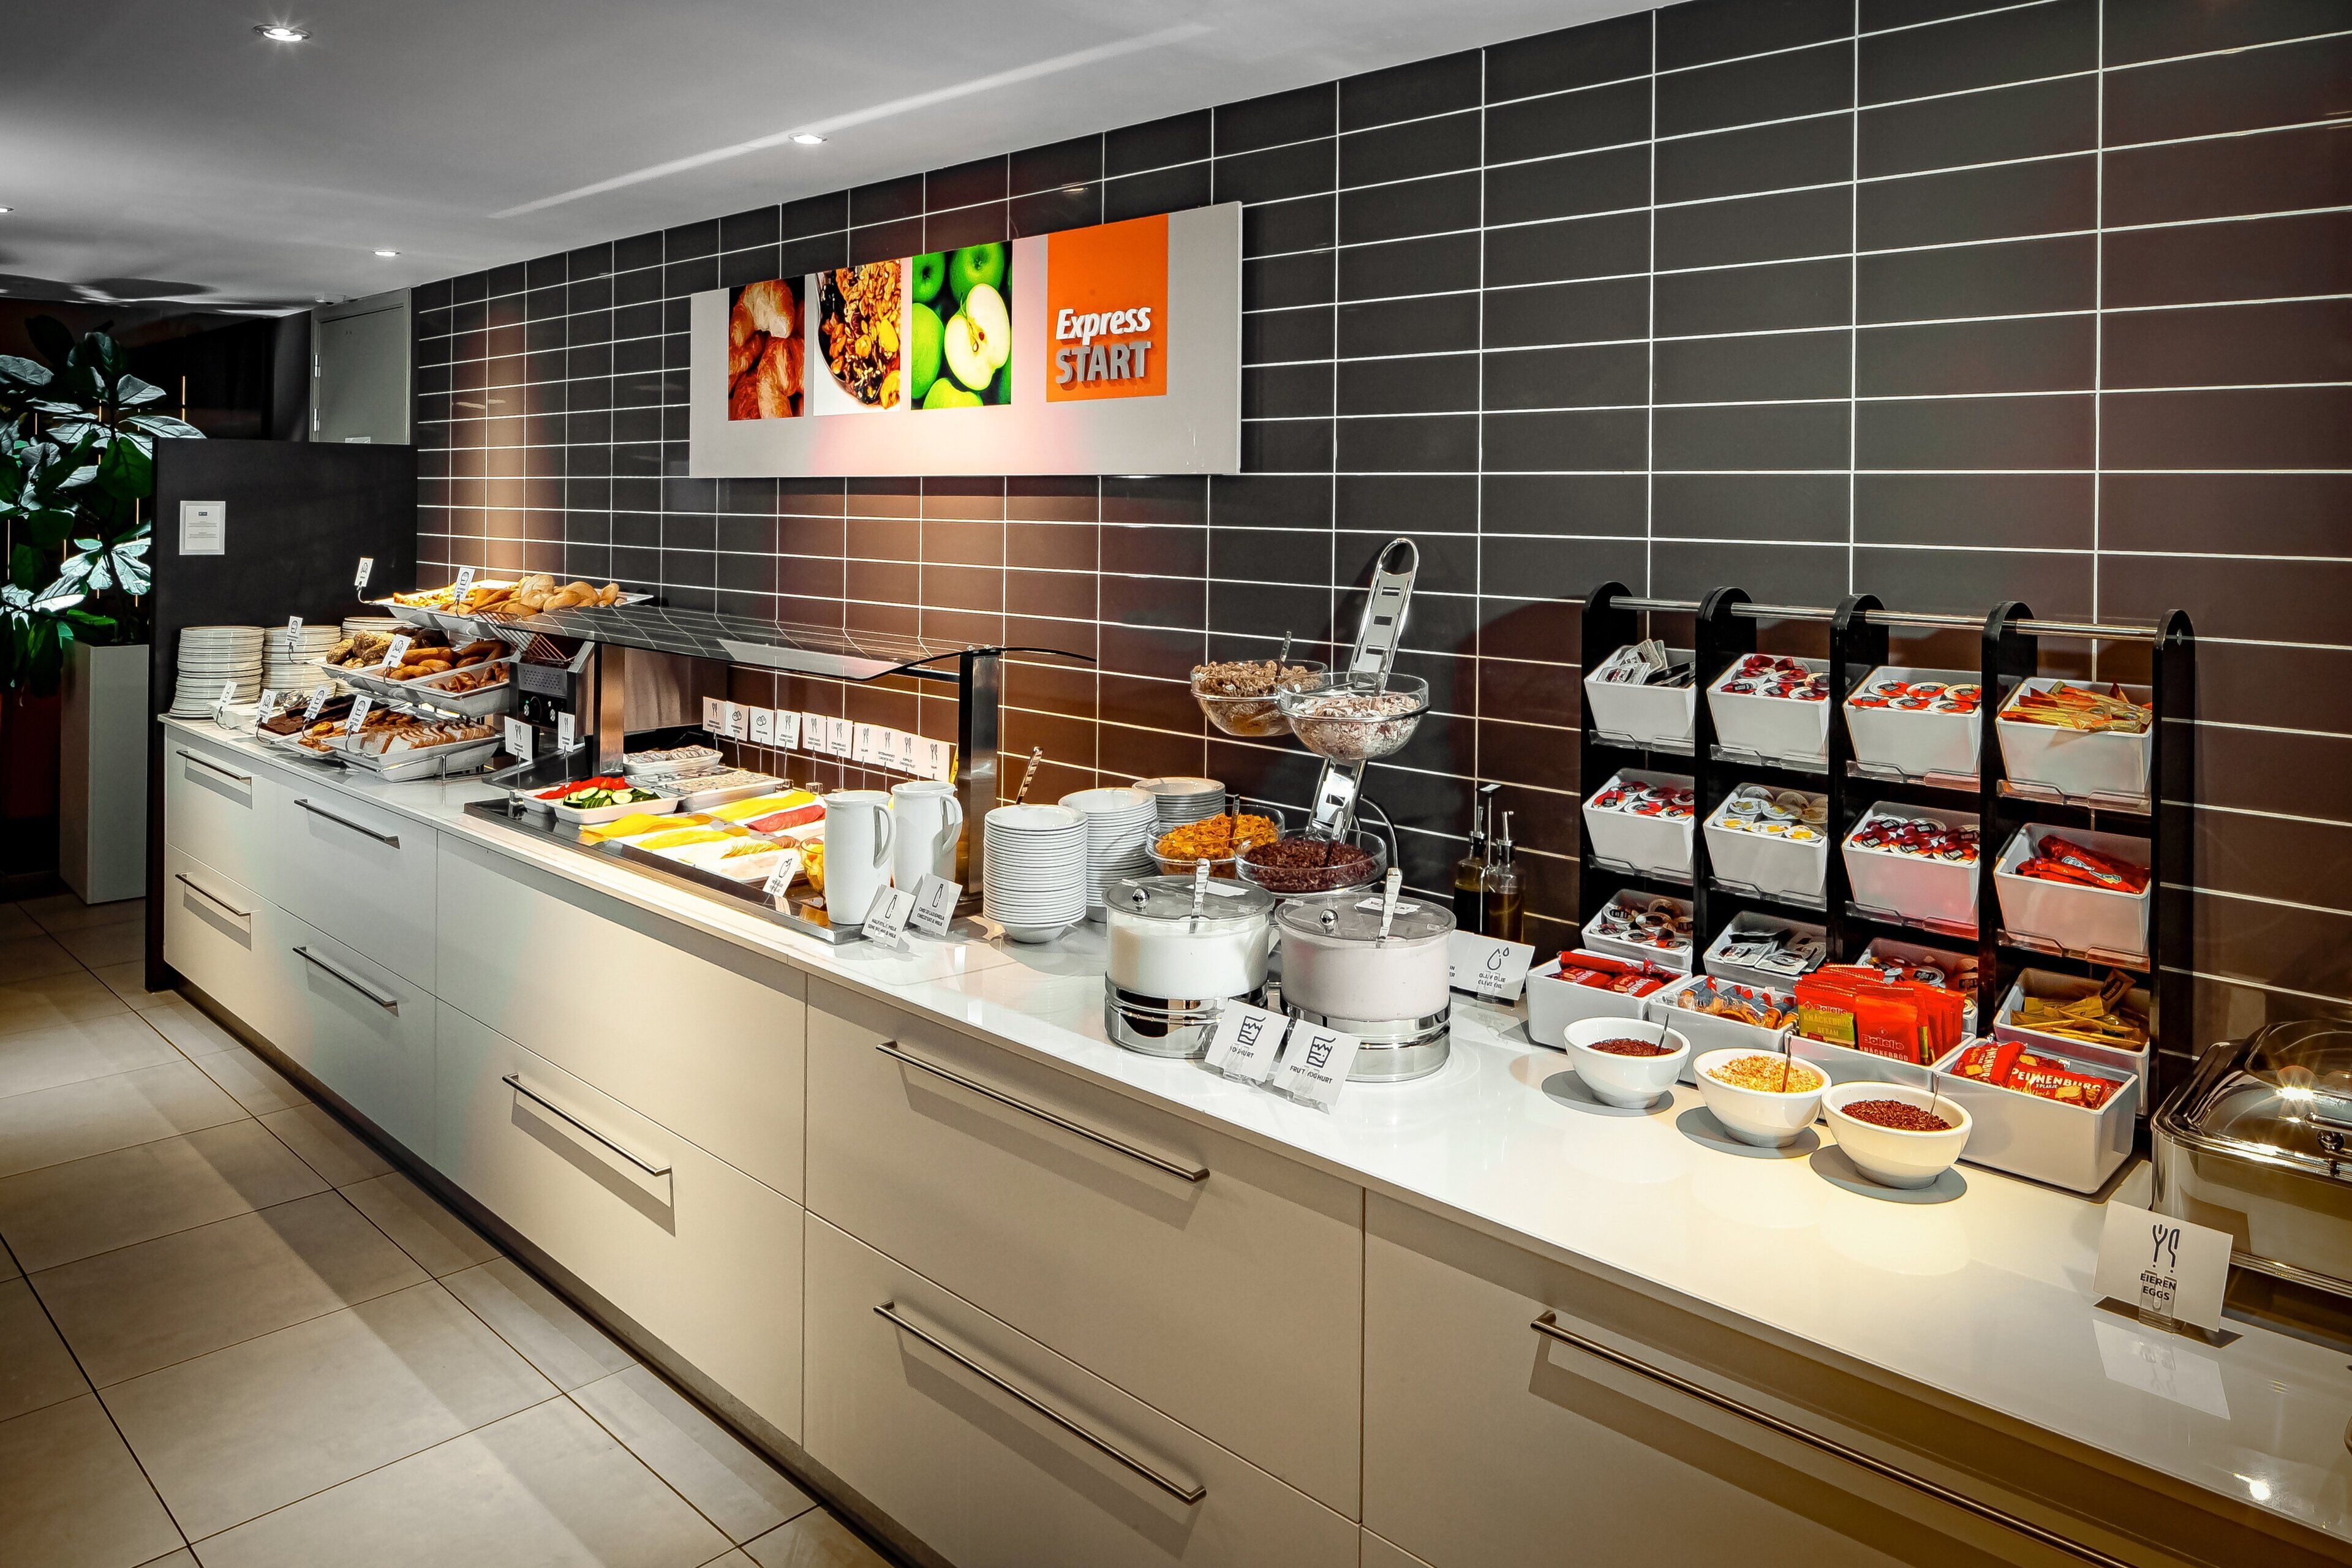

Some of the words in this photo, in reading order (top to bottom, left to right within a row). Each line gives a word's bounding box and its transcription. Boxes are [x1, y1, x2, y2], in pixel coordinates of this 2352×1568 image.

[1055, 307, 1152, 345] Express
[1055, 341, 1152, 384] START
[1814, 1004, 1848, 1015] Bolletje
[1862, 1034, 1904, 1050] Bolletje
[1289, 1065, 1306, 1075] FRUT
[2140, 1273, 2177, 1291] EIEREN
[2143, 1286, 2170, 1300] EGGS
